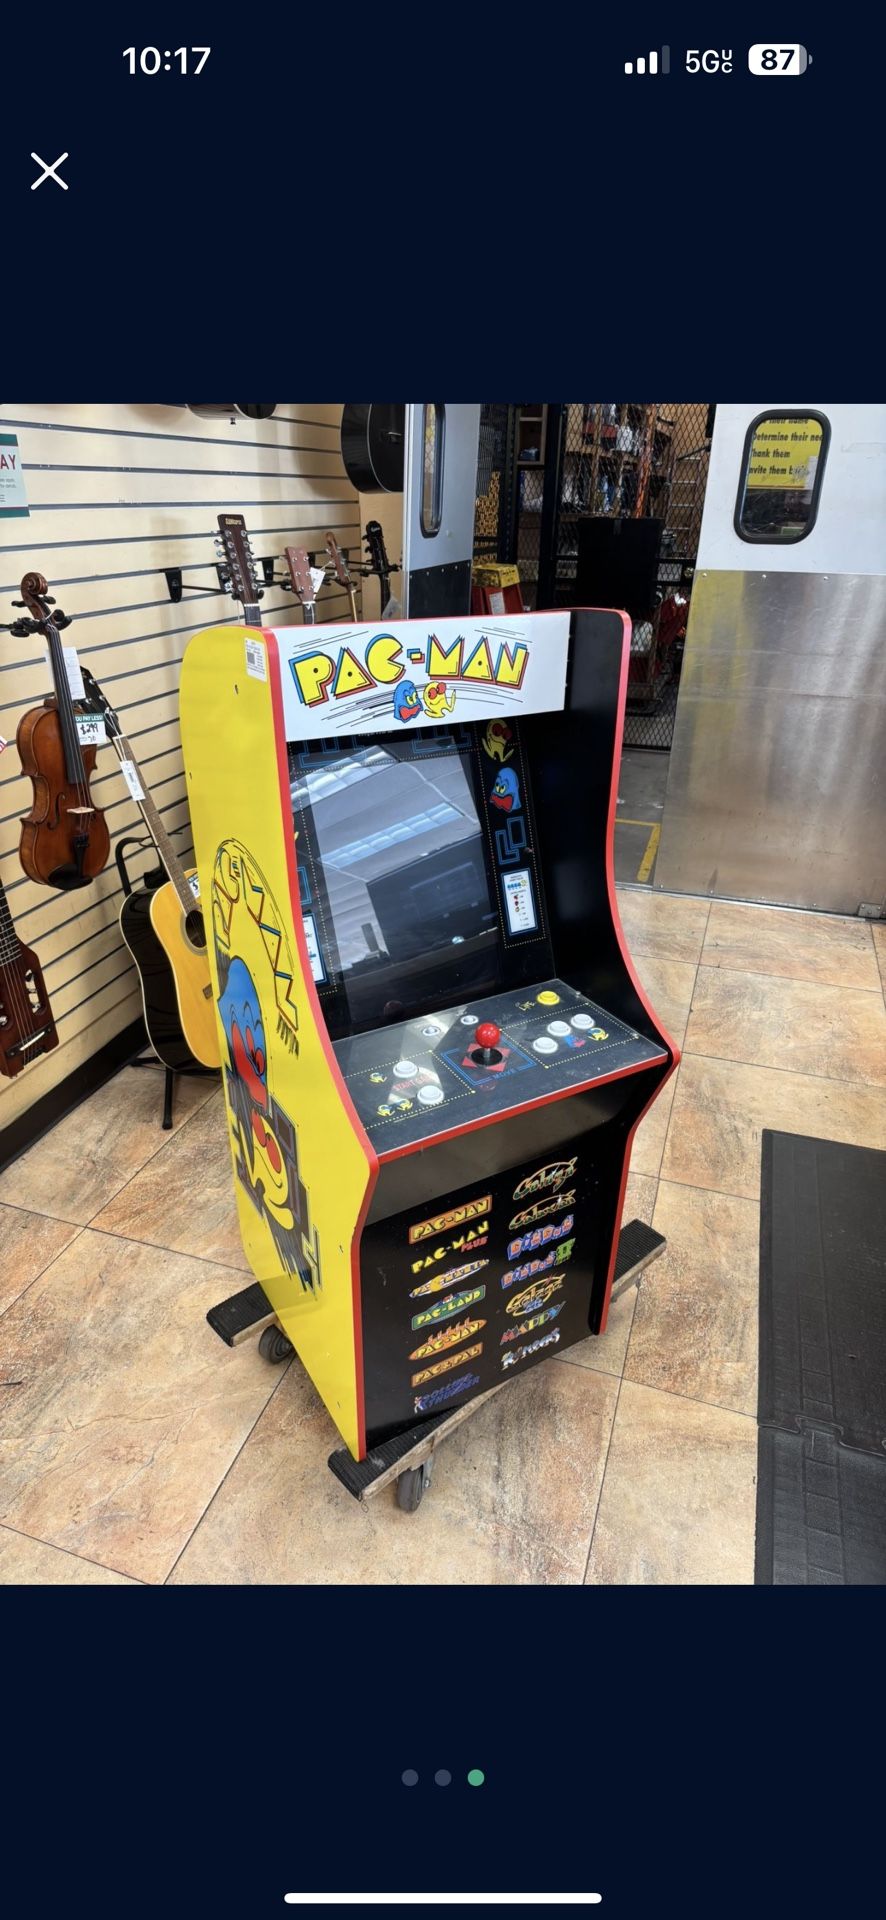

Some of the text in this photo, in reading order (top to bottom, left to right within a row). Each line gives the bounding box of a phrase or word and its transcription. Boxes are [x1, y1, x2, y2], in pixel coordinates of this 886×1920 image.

[752, 448, 791, 457] hank them
[791, 432, 809, 441] their
[769, 465, 787, 475] them
[288, 633, 530, 709] PAC-MAN
[412, 1198, 489, 1241] PAC-MAN
[411, 1220, 489, 1274] PAC-MAN
[416, 1290, 481, 1325] PAC-LAND
[415, 1321, 480, 1359] PAC-MAN
[415, 1365, 441, 1384] PAC
[453, 1347, 480, 1366] PAL
